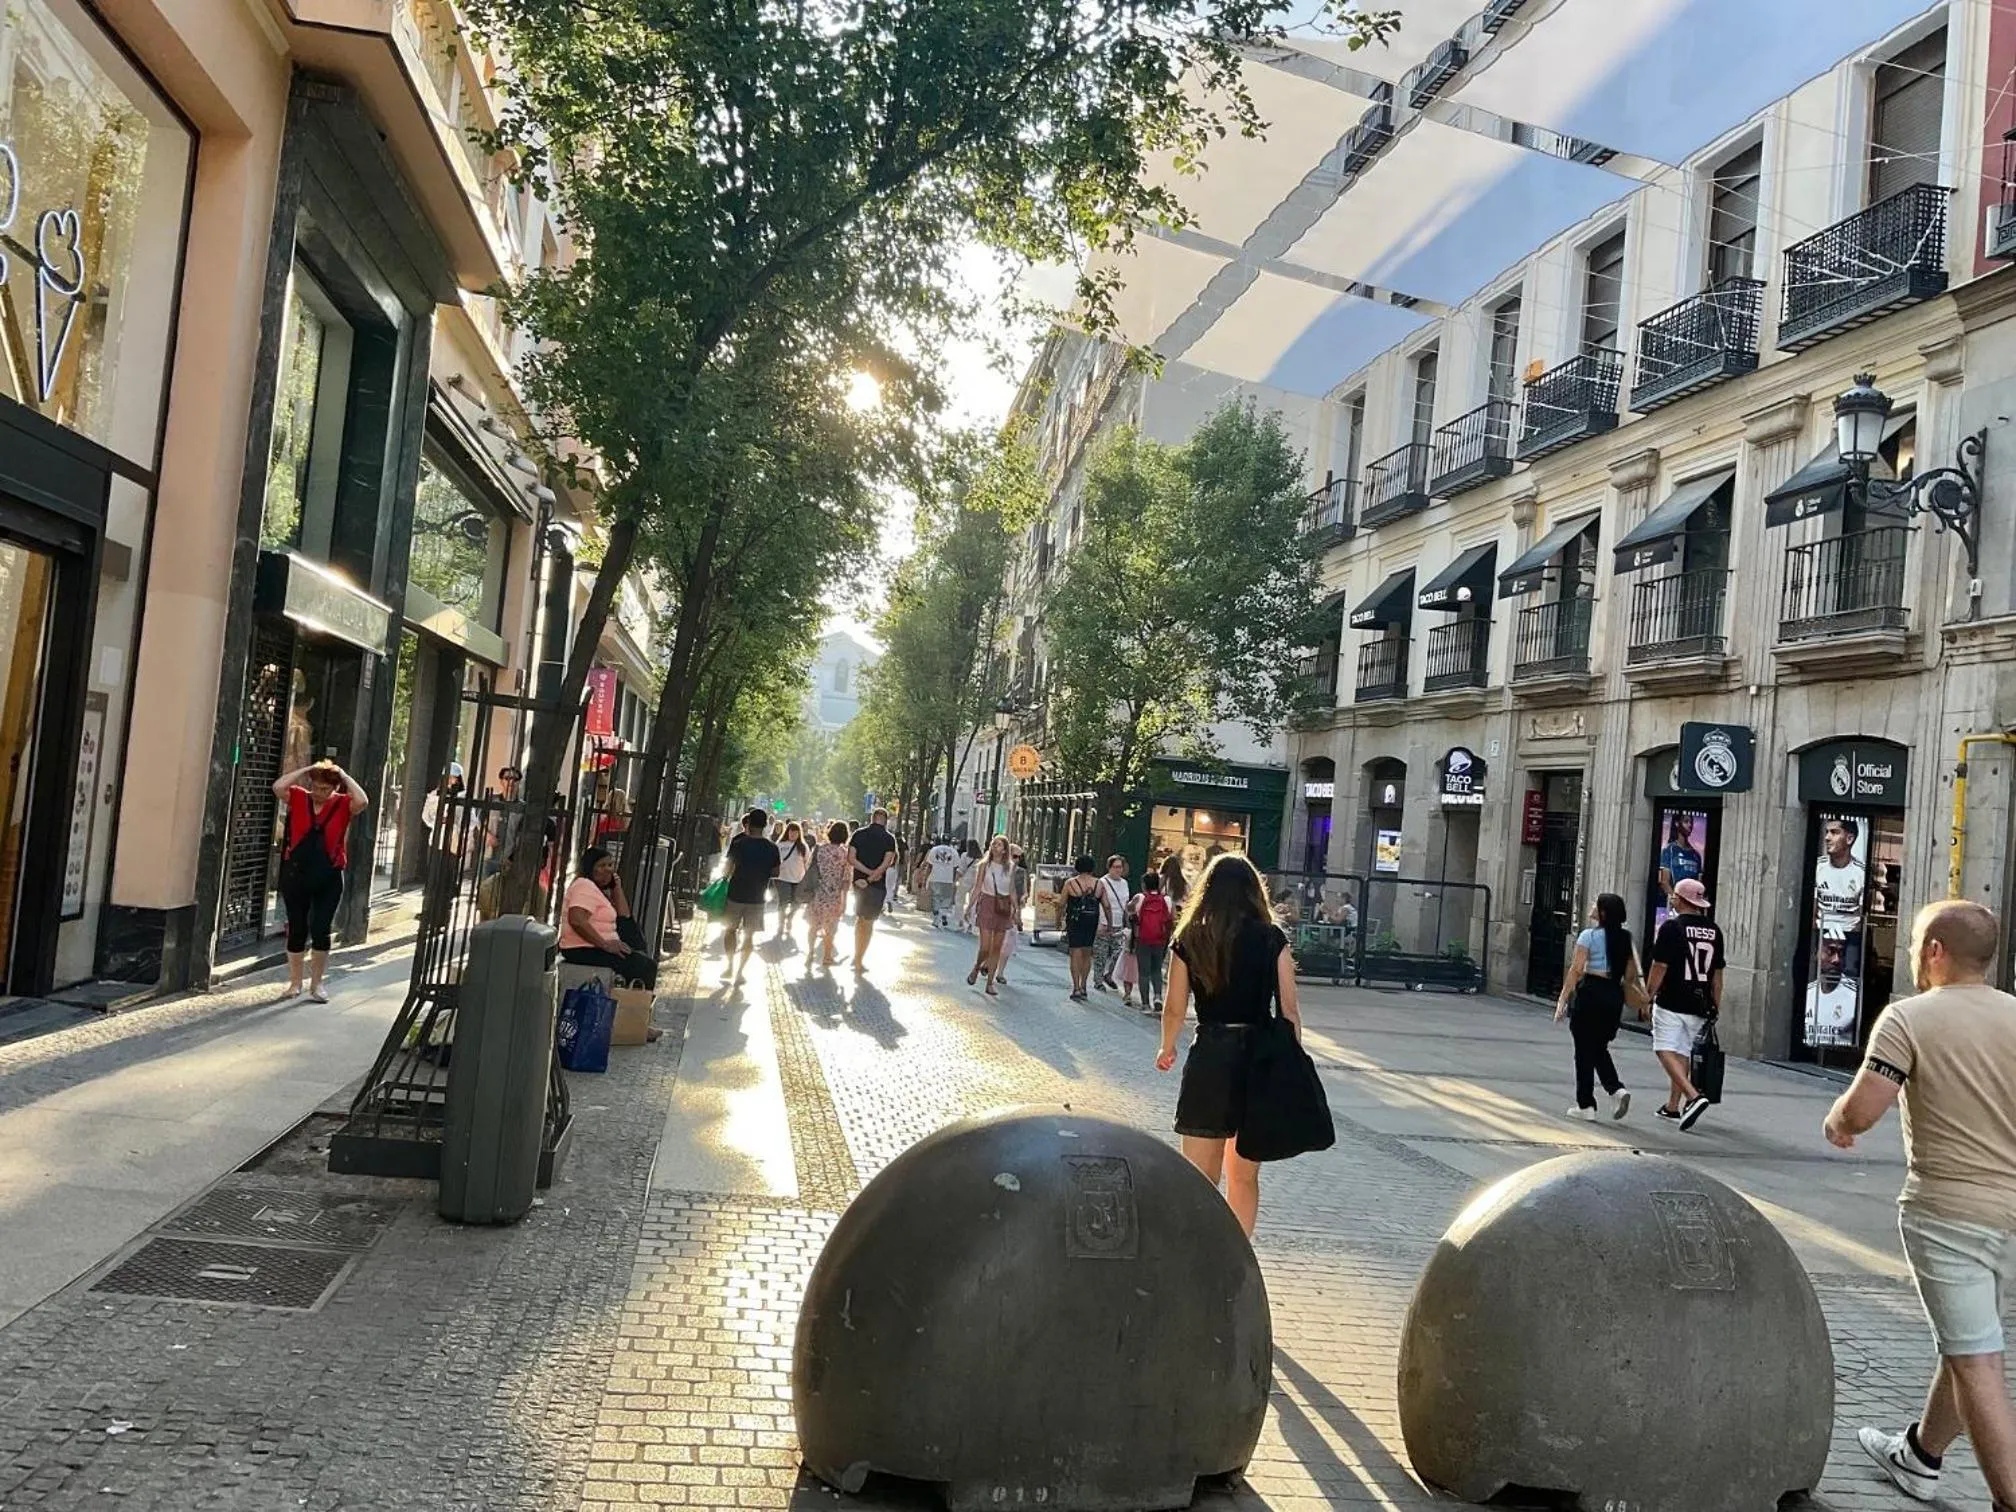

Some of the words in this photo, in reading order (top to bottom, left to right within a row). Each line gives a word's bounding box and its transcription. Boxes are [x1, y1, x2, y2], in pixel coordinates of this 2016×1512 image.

[1419, 592, 1434, 604] TACO
[1433, 588, 1448, 602] BELL
[1857, 763, 1892, 778] Official
[1445, 773, 1472, 784] TACO
[1305, 783, 1321, 798] TACO
[1446, 782, 1471, 793] BELL
[1856, 779, 1884, 795] Store
[1686, 926, 1716, 940] MESSI
[1684, 940, 1714, 982] 10
[992, 1486, 1048, 1502] 019
